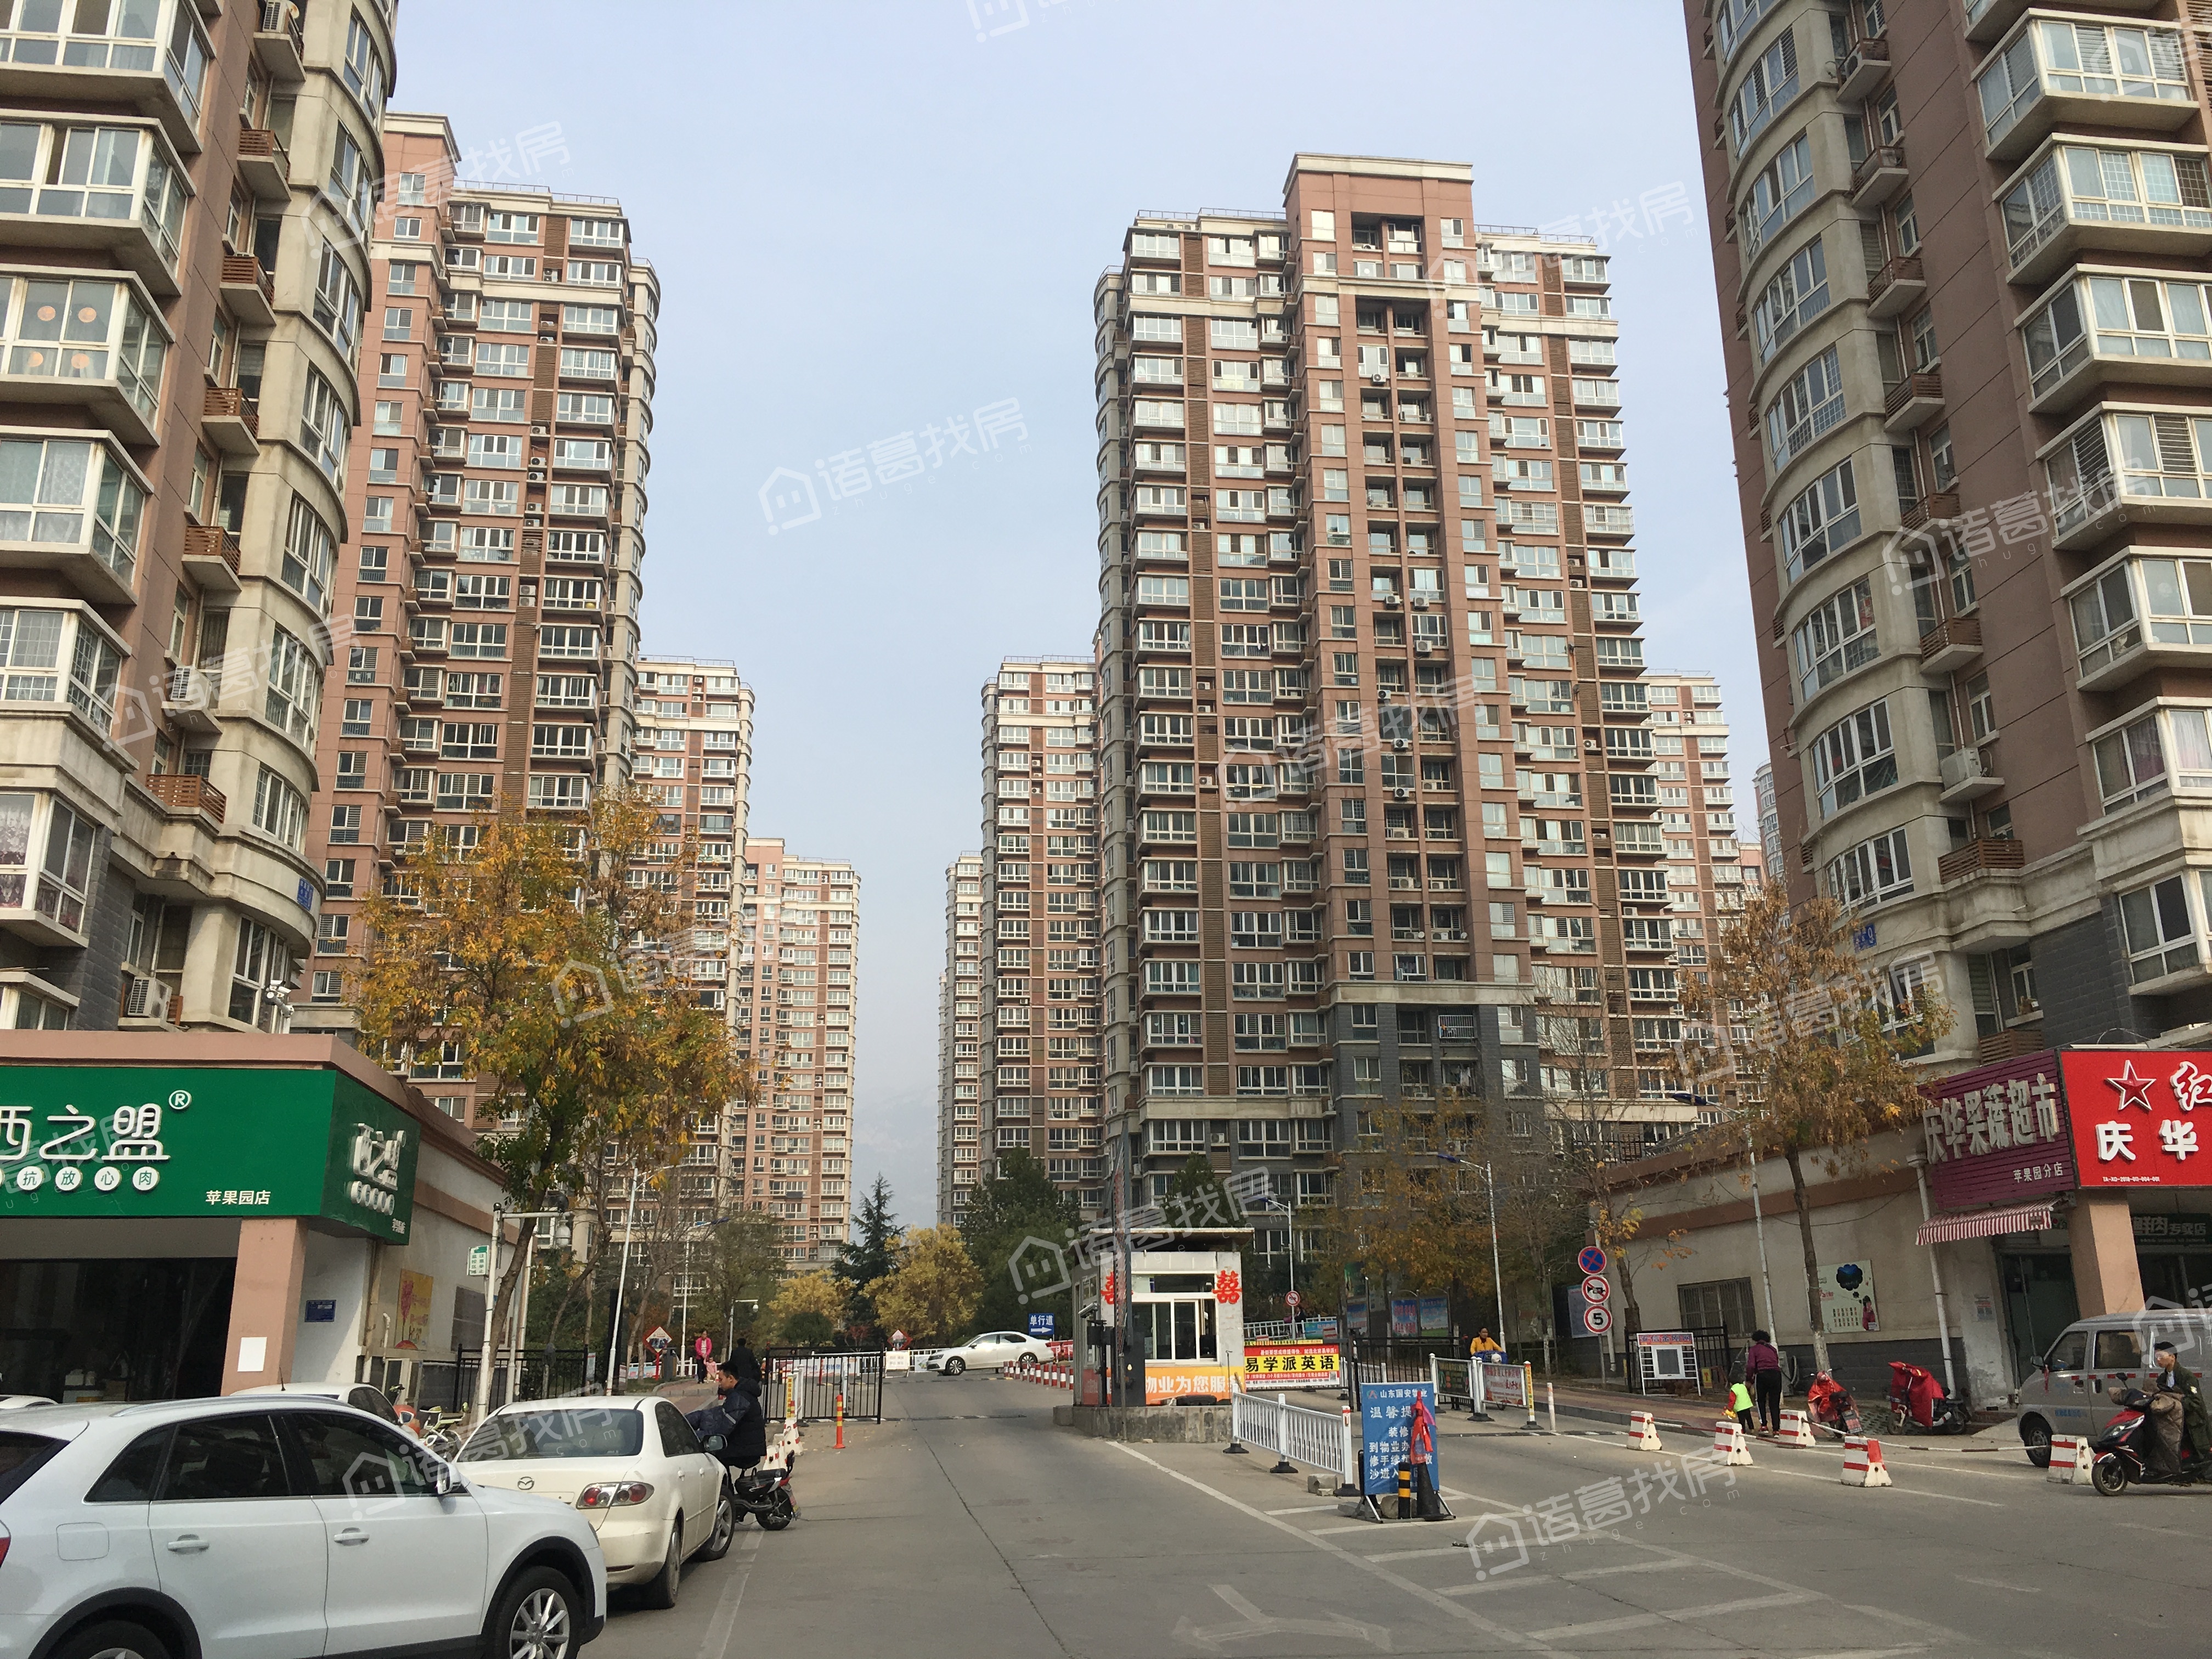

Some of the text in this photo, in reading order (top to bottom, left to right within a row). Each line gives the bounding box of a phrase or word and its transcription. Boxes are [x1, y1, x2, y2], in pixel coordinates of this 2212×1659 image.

[1922, 1073, 2059, 1164] 庆华果蔬超市
[2095, 1119, 2199, 1161] 庆华
[2013, 1161, 2063, 1183] 苹果园分店
[205, 1189, 271, 1205] 苹果园店
[1030, 1314, 1053, 1326] 单行道
[1593, 1312, 1604, 1325] 5
[1245, 1355, 1335, 1372] 易学派英语
